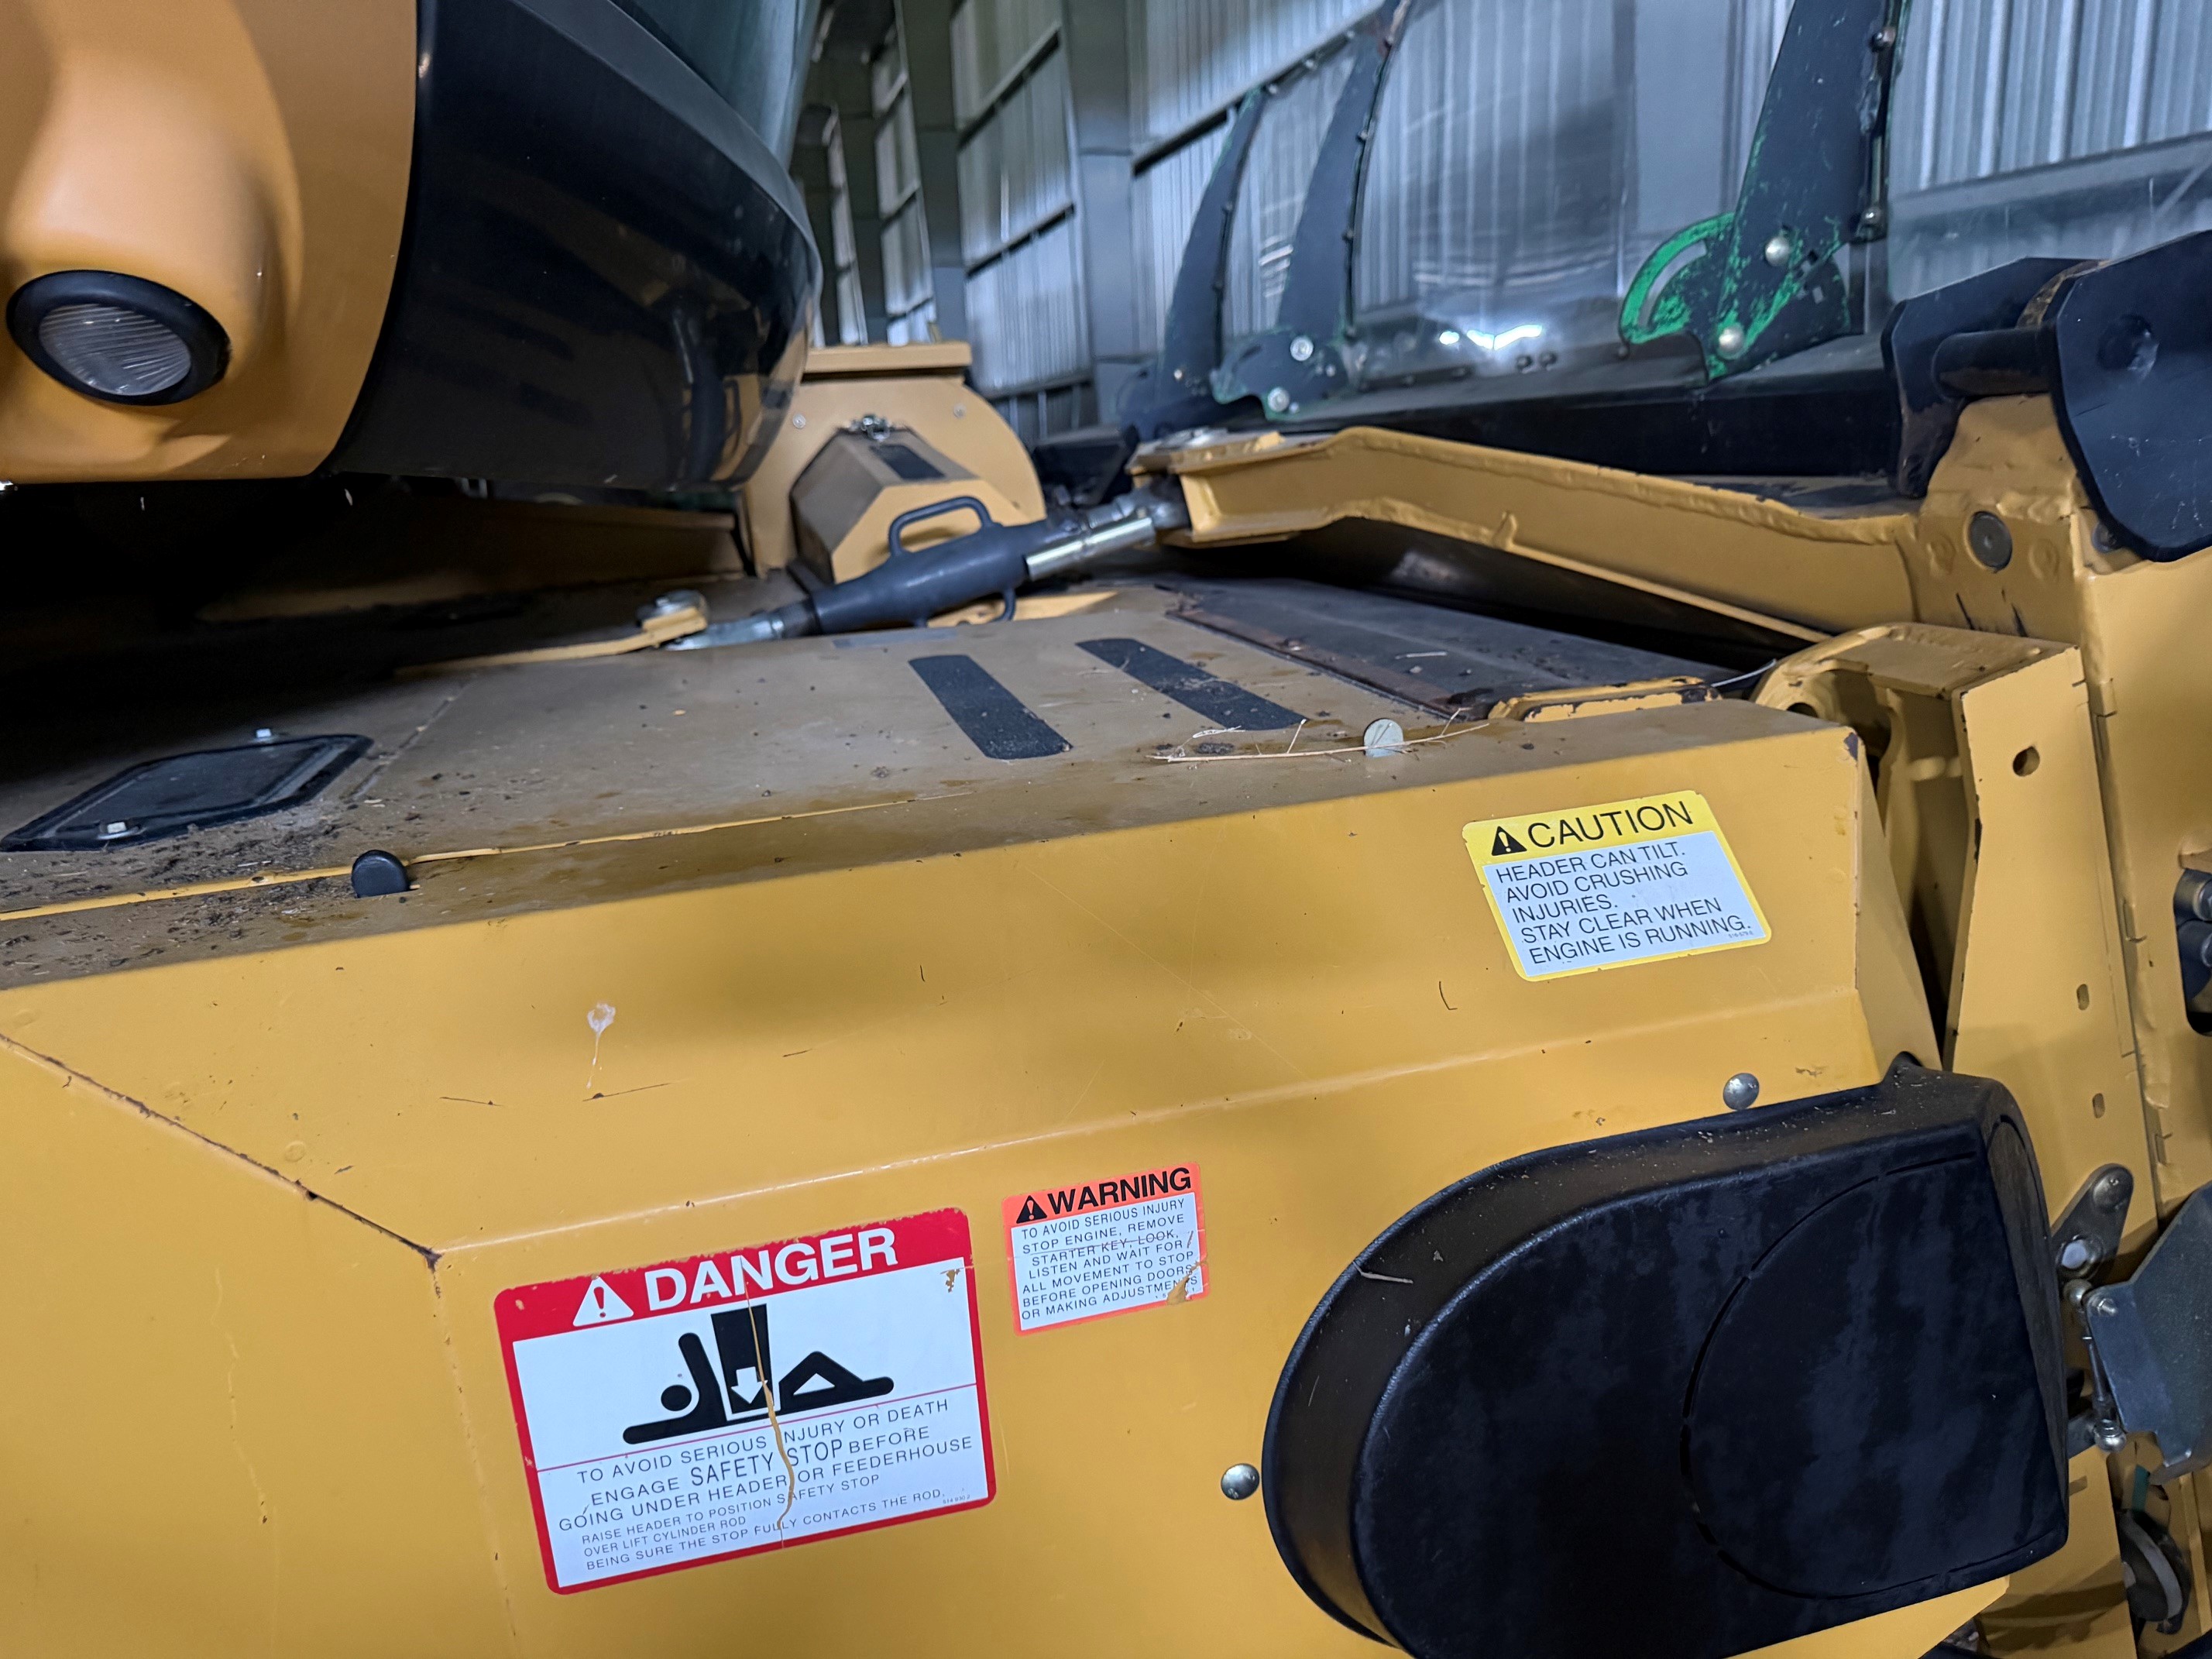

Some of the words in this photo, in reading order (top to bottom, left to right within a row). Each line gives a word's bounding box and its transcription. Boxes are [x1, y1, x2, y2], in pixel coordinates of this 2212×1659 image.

[1527, 801, 1694, 848] CAUTION
[1496, 857, 1585, 883] HEADER
[1592, 848, 1636, 868] CAN
[1506, 880, 1568, 903] AVOID
[1575, 862, 1688, 893] CRUSHING
[1520, 921, 1570, 943] STAY
[1578, 908, 1653, 932] CLEAR
[1654, 898, 1722, 921] WHEN
[1529, 934, 1616, 964] ENGINE
[1620, 930, 1641, 949] IS
[1047, 1167, 1191, 1215] WARNING
[1022, 1228, 1038, 1239] TO
[1042, 1219, 1080, 1236] AVOID
[1084, 1208, 1138, 1227] SERIOUS
[1143, 1198, 1184, 1215] INJURY
[1023, 1238, 1060, 1255] STOP
[1128, 1214, 1184, 1233] REMOVE
[644, 1228, 898, 1311] DANGER
[1022, 1279, 1046, 1294] ALL
[1052, 1264, 1129, 1288] MOVEMENT
[1135, 1259, 1152, 1272] TO
[1159, 1251, 1194, 1266] STOP
[1029, 1262, 1077, 1279] LISTEN
[1084, 1255, 1111, 1269] AND
[1116, 1246, 1150, 1262] WAIT
[1156, 1240, 1183, 1254] FOR
[1032, 1246, 1096, 1266] STARTER
[1022, 1309, 1040, 1320] OR
[1046, 1297, 1097, 1316] MAKING
[1103, 1276, 1197, 1304] ADJUSTMES
[1023, 1290, 1077, 1307] BEFORE
[1081, 1275, 1142, 1296] OPENING
[577, 1468, 603, 1484] TO
[613, 1455, 672, 1479] AVOID
[681, 1436, 767, 1464] SERIOUS
[781, 1420, 845, 1444] NJURY
[854, 1414, 880, 1429] OR
[888, 1399, 948, 1423] DEATH
[558, 1508, 623, 1531] GOING
[632, 1492, 699, 1516] UNDER
[709, 1475, 787, 1501] HEADER
[798, 1467, 824, 1482] OR
[833, 1436, 973, 1477] FEEDERHOUSE
[591, 1477, 680, 1506] ENGAGE
[690, 1452, 773, 1486] SAFETY
[787, 1439, 842, 1466] STOP
[850, 1426, 930, 1454] BEFORE
[582, 1528, 622, 1544] RAISE
[627, 1516, 682, 1534] HEADER
[685, 1512, 704, 1523] TO
[709, 1498, 771, 1518] POSITION
[841, 1475, 879, 1491] STOP
[584, 1543, 618, 1557] OVER
[623, 1536, 647, 1549] LIFT
[653, 1523, 715, 1543] CYLINDER
[720, 1516, 746, 1529] ROD
[587, 1553, 630, 1570] BEING
[636, 1545, 674, 1560] SURE
[678, 1538, 706, 1551] THE
[712, 1530, 748, 1544] STOP
[803, 1503, 876, 1525] CONTACTS
[882, 1496, 908, 1509] THE
